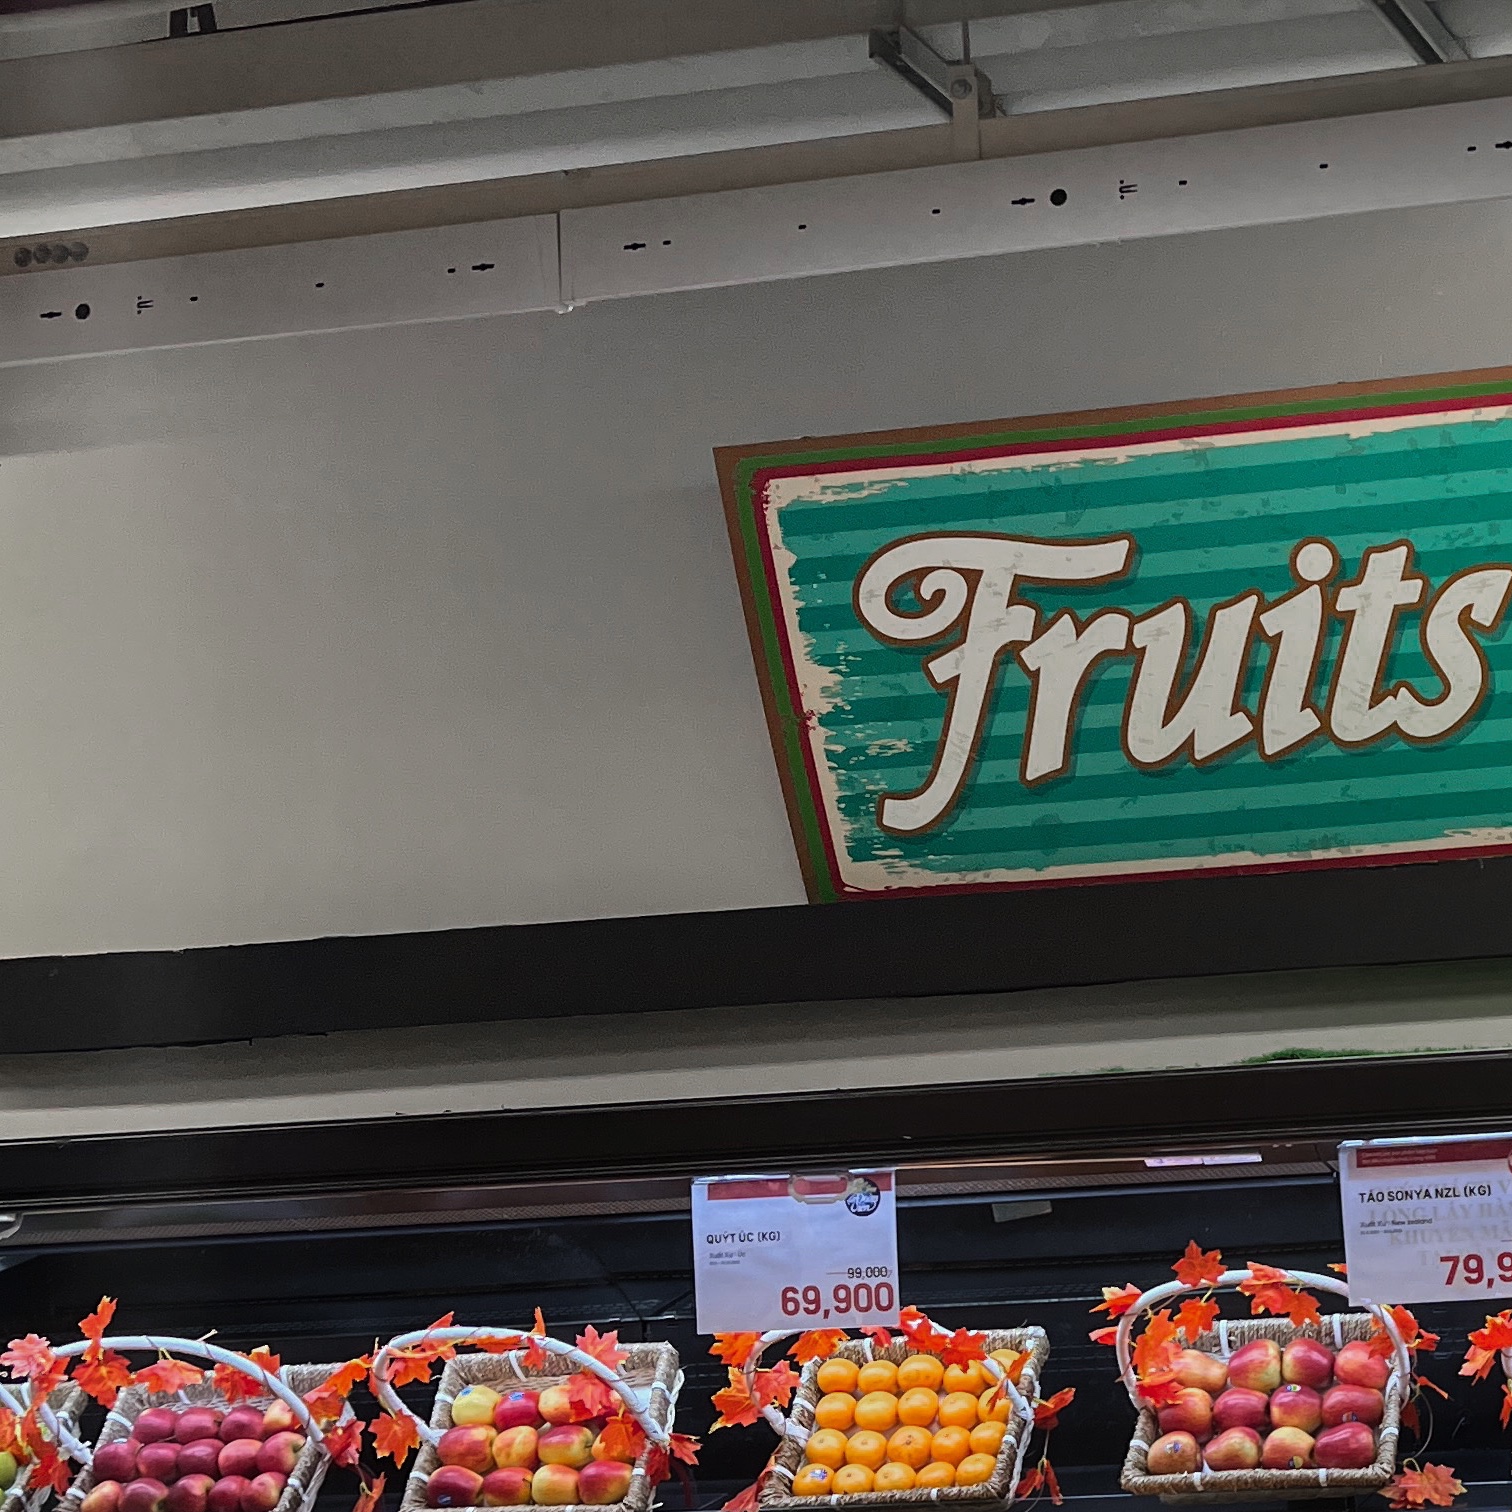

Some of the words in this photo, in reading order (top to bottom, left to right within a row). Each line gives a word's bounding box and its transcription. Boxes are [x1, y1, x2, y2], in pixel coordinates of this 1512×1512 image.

[1358, 1187, 1385, 1203] TÁO
[1387, 1187, 1432, 1202] SONYA
[1434, 1186, 1461, 1199] NZL
[1463, 1184, 1492, 1198] (KG)
[706, 1231, 736, 1244] QUÝT
[738, 1230, 754, 1243] ÚC
[757, 1230, 781, 1242] (KG)
[847, 1266, 888, 1280] 99,000
[780, 1282, 895, 1320] 69,900
